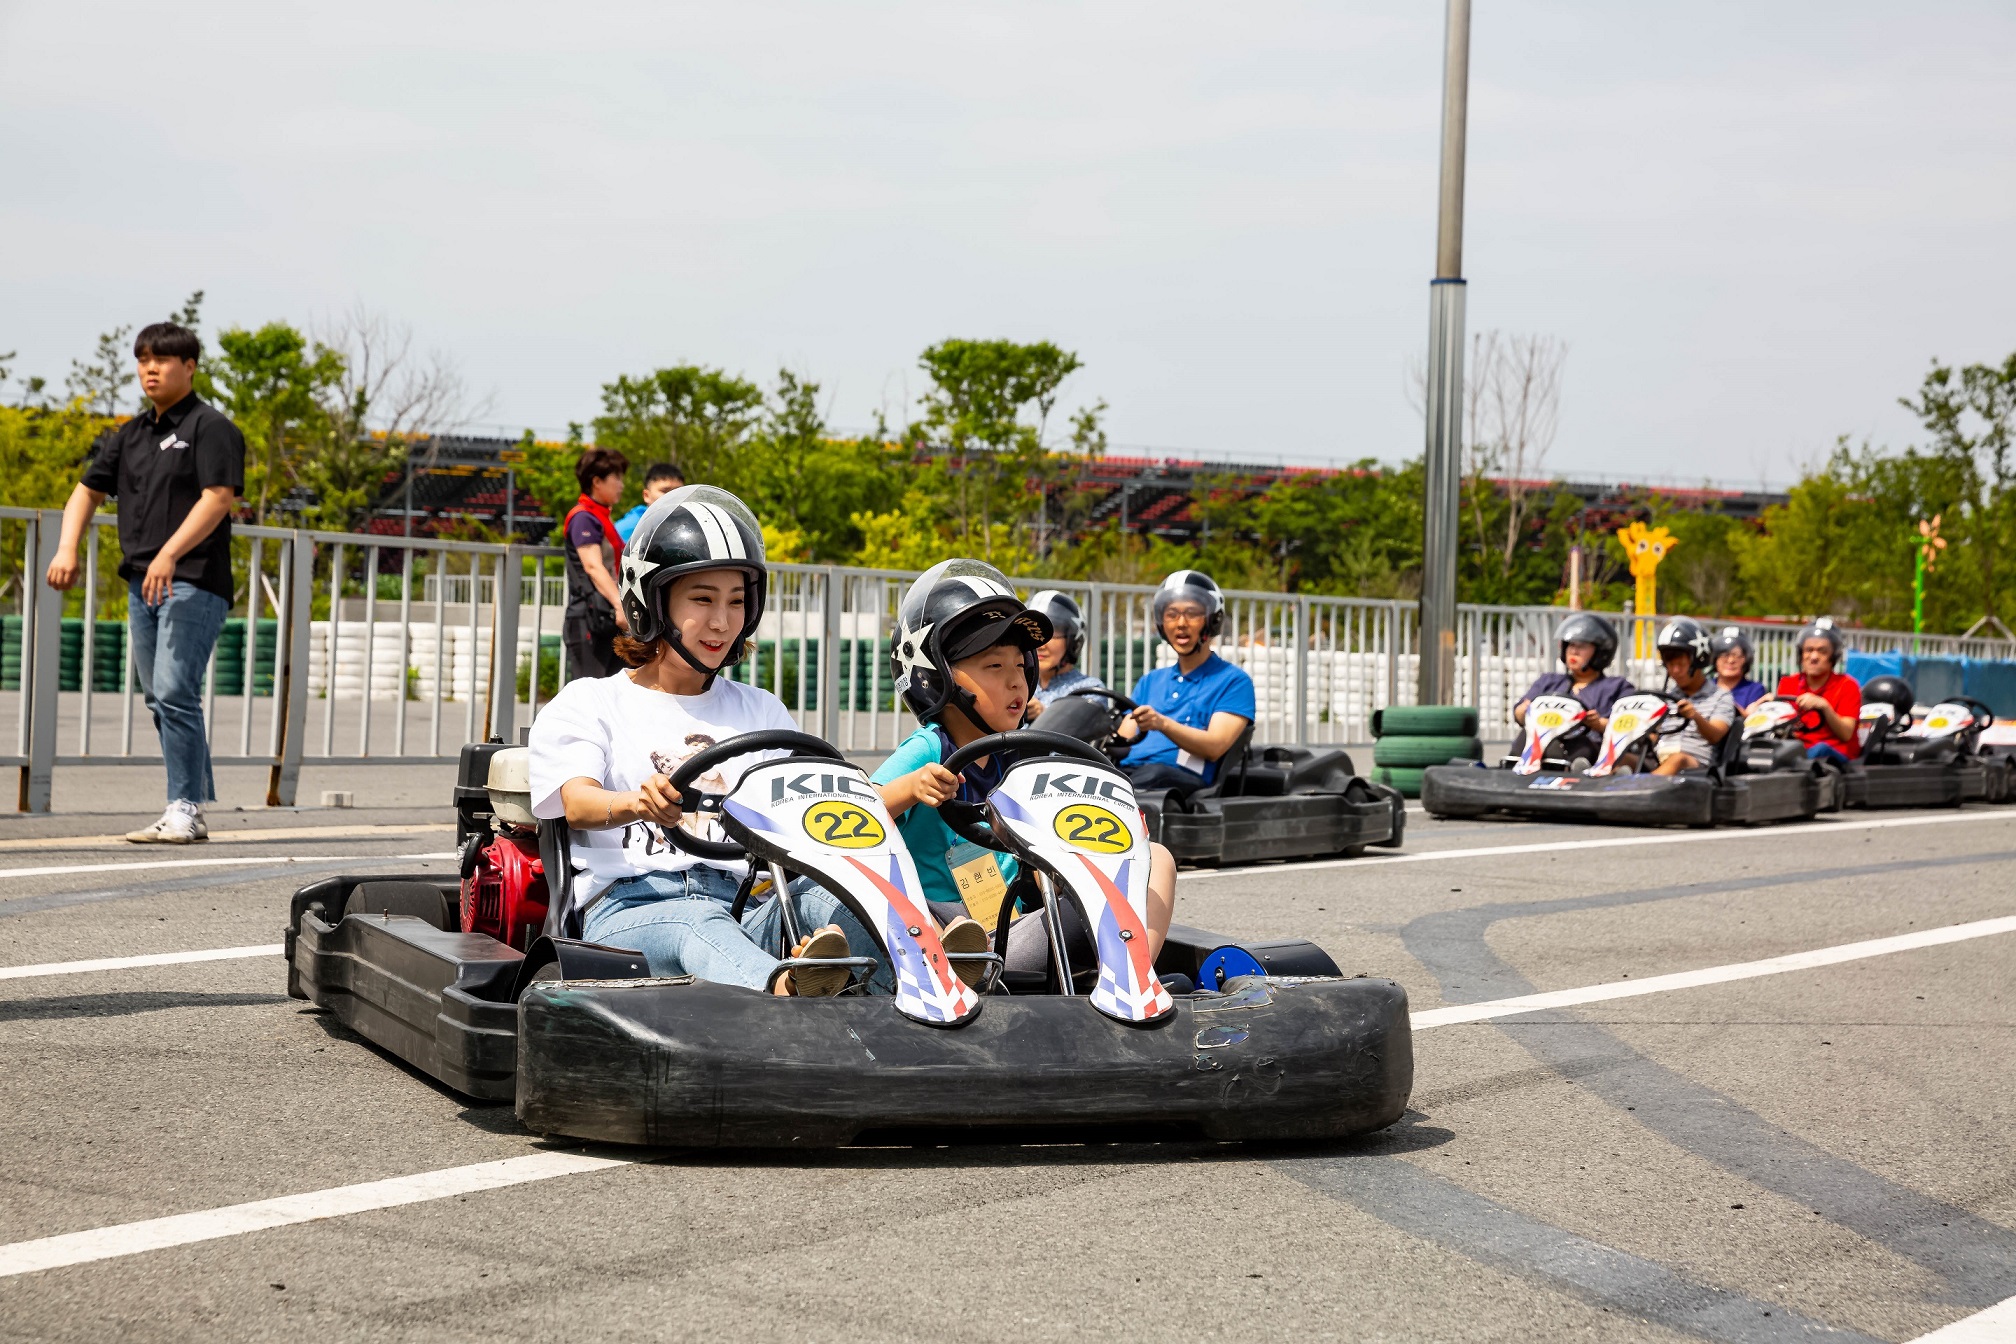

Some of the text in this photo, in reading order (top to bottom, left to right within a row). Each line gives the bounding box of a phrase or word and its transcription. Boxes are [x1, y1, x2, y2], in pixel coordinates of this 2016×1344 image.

[771, 796, 794, 808] KOREA
[772, 774, 877, 802] KIC
[1030, 793, 1053, 801] KOREA
[1057, 792, 1110, 803] INTERNATIONAL
[1031, 773, 1135, 809] KIC
[814, 810, 880, 841] 22
[1065, 813, 1125, 847] 22
